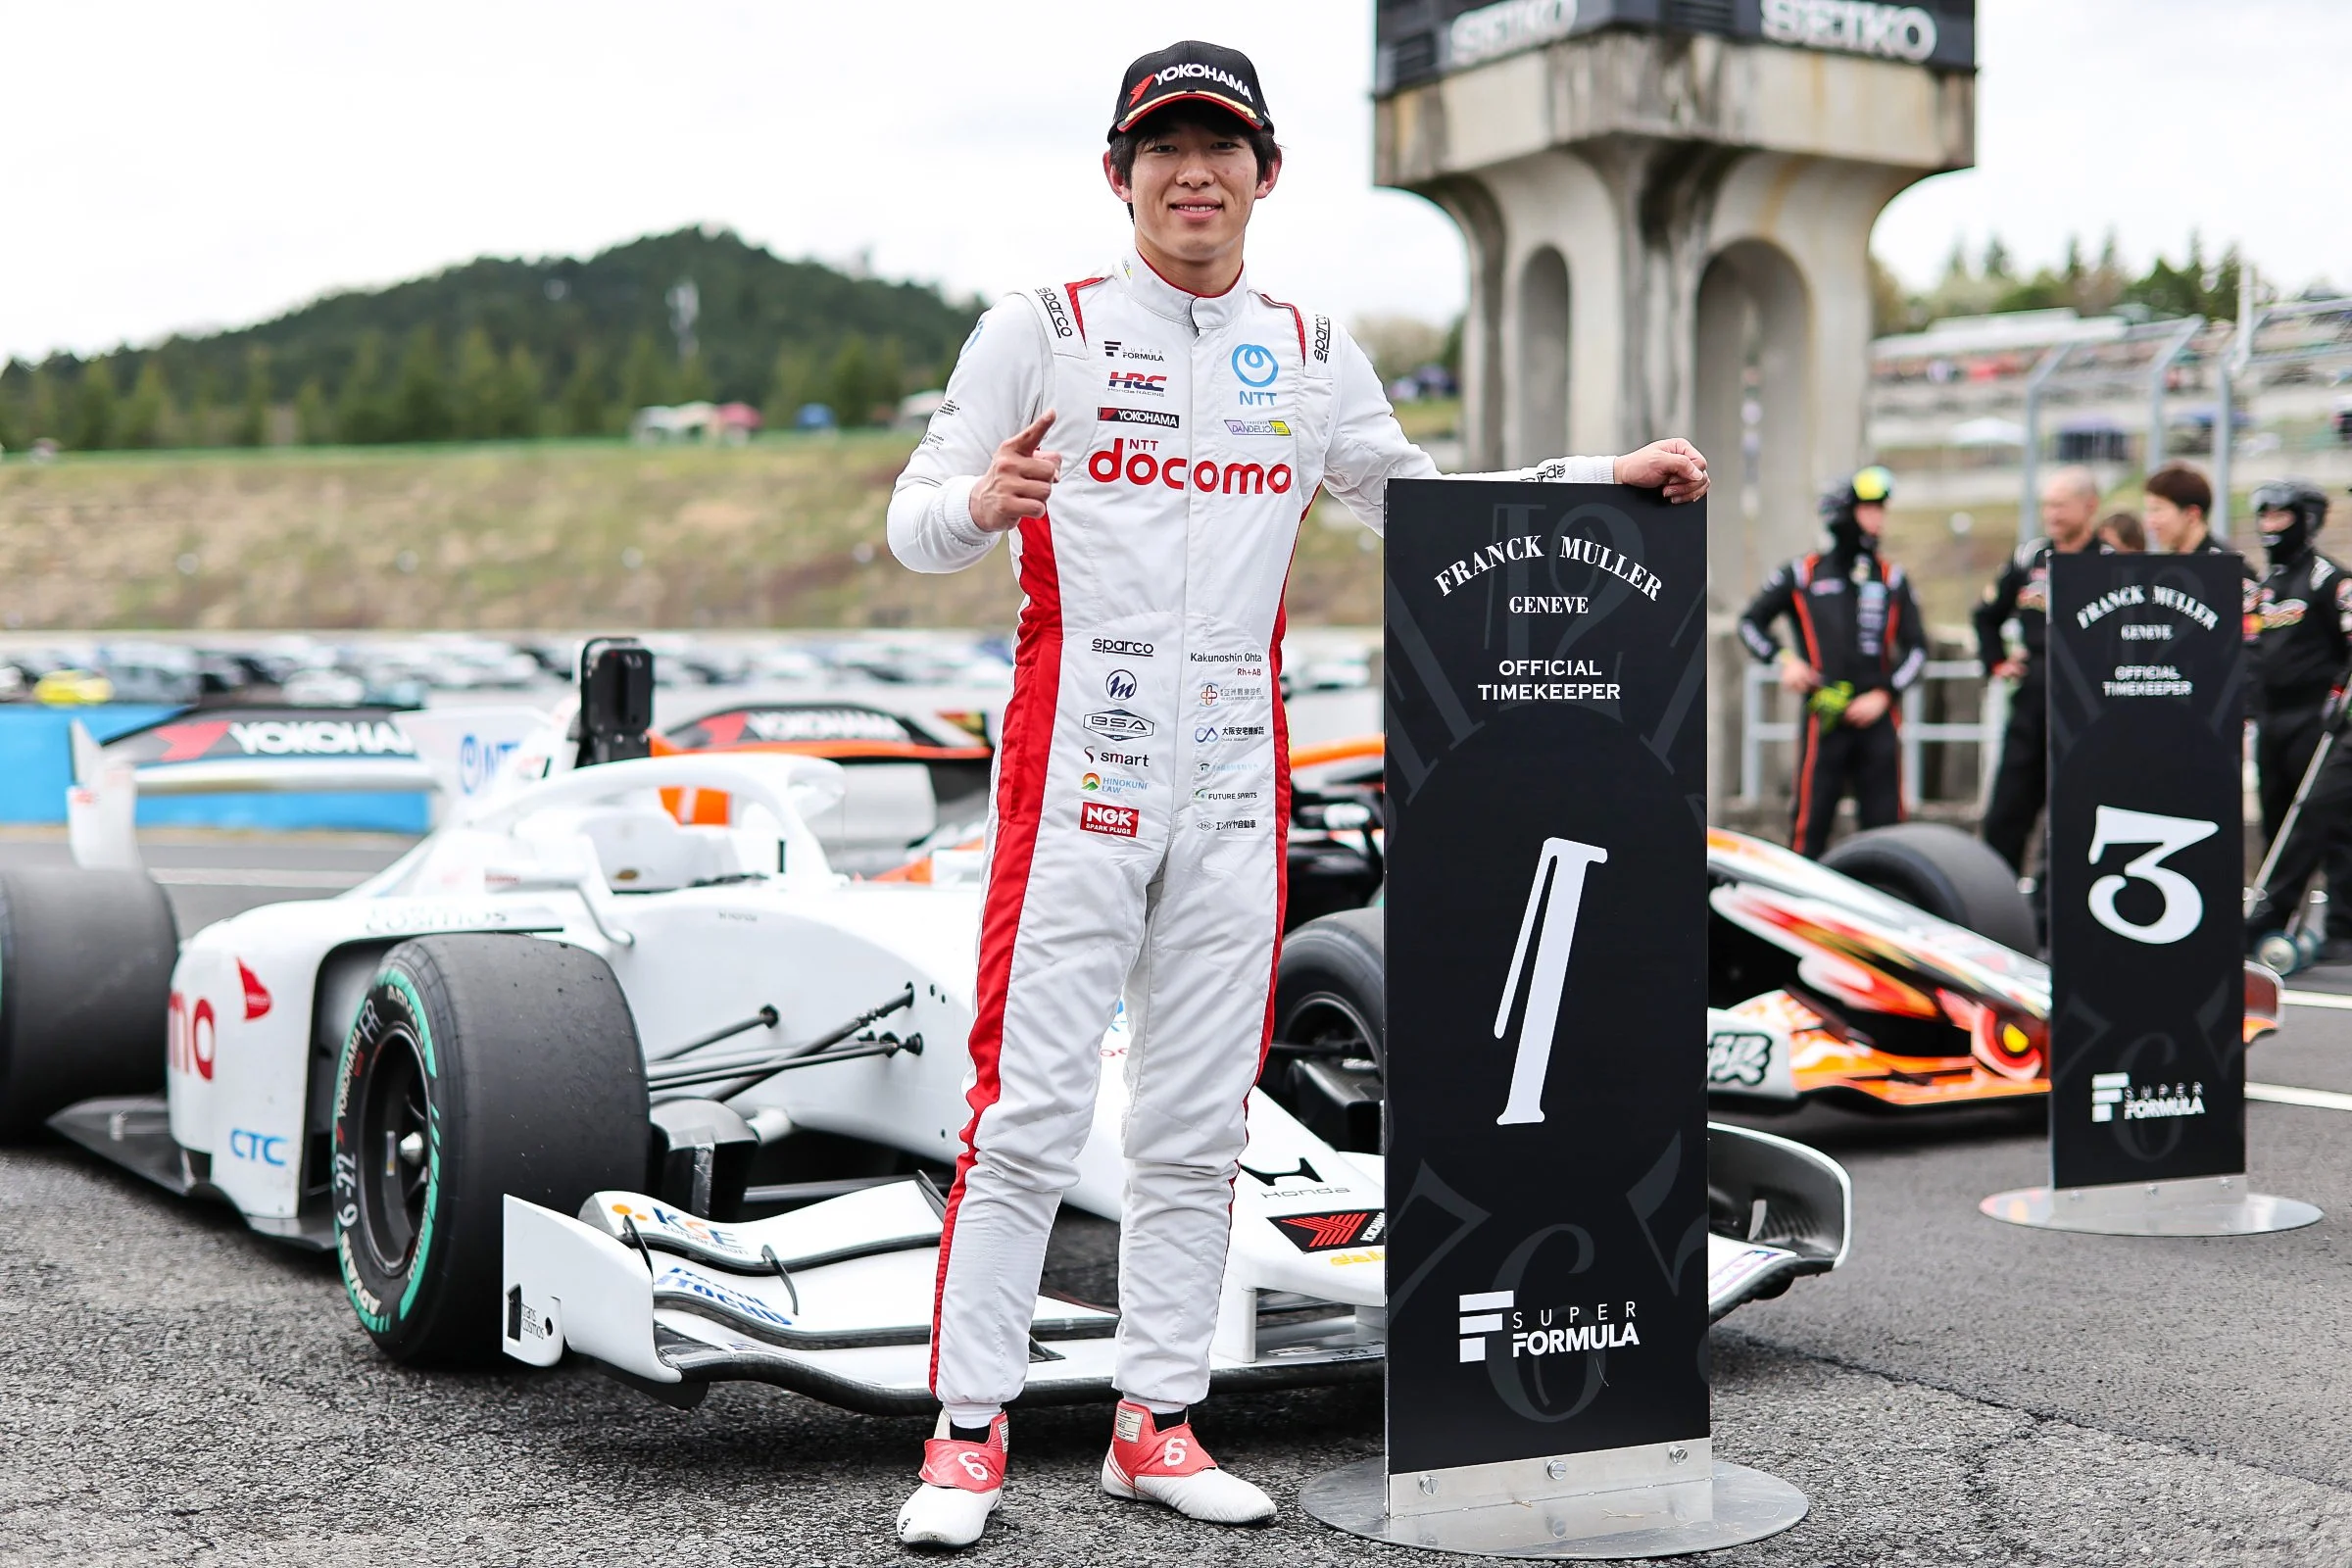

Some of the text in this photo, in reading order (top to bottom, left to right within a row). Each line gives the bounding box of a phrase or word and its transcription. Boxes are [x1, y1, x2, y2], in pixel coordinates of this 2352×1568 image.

[1761, 0, 1936, 64] SEIKO
[1154, 64, 1253, 103] YOKOHAMA
[1035, 287, 1072, 338] sparco
[1123, 352, 1164, 362] FORMULA
[1108, 371, 1167, 392] HRC
[1240, 391, 1277, 406] NTT
[1118, 410, 1178, 426] YOKOHAMA
[1232, 424, 1277, 433] DANDELION
[1129, 439, 1158, 451] NTT
[1089, 438, 1292, 495] docomo
[1434, 535, 1662, 601] FRANCK MULLER
[1509, 596, 1589, 614] GENEVE
[2077, 585, 2145, 629] FRANCK
[2152, 585, 2219, 631] MULLER
[1092, 638, 1153, 657] sparco
[1191, 653, 1262, 662] Kakunoshin Ohta
[1498, 660, 1602, 676] OFFICIAL
[2115, 665, 2181, 681] OFFICIAL
[1478, 683, 1621, 701] TIMEKEEPER
[2102, 681, 2193, 697] TIMEKEEPER
[1092, 715, 1147, 731] BSA
[227, 721, 415, 755] YOKOHA
[1101, 752, 1150, 767] smart
[1102, 777, 1148, 790] HINOKUNI
[1102, 785, 1121, 794] LAW
[1087, 806, 1133, 827] NGK
[1086, 822, 1131, 835] SPARK PLUGS
[2088, 805, 2220, 945] 3
[1494, 836, 1608, 1125] 1
[336, 1028, 362, 1117] YOKOHAMA
[2125, 1081, 2203, 1101] SUPER
[2124, 1095, 2205, 1120] FORMULA
[231, 1128, 288, 1166] CTC
[1261, 1187, 1350, 1199] Honda
[653, 1206, 743, 1249] KSE
[662, 1226, 749, 1255] corporation
[655, 1274, 793, 1325] ITOCHU
[521, 1302, 537, 1322] trans
[1513, 1300, 1637, 1329] SUPER
[522, 1317, 545, 1340] cosmos
[1513, 1322, 1640, 1357] FORMULA
[1163, 1437, 1188, 1467] 6
[957, 1451, 988, 1481] 6
